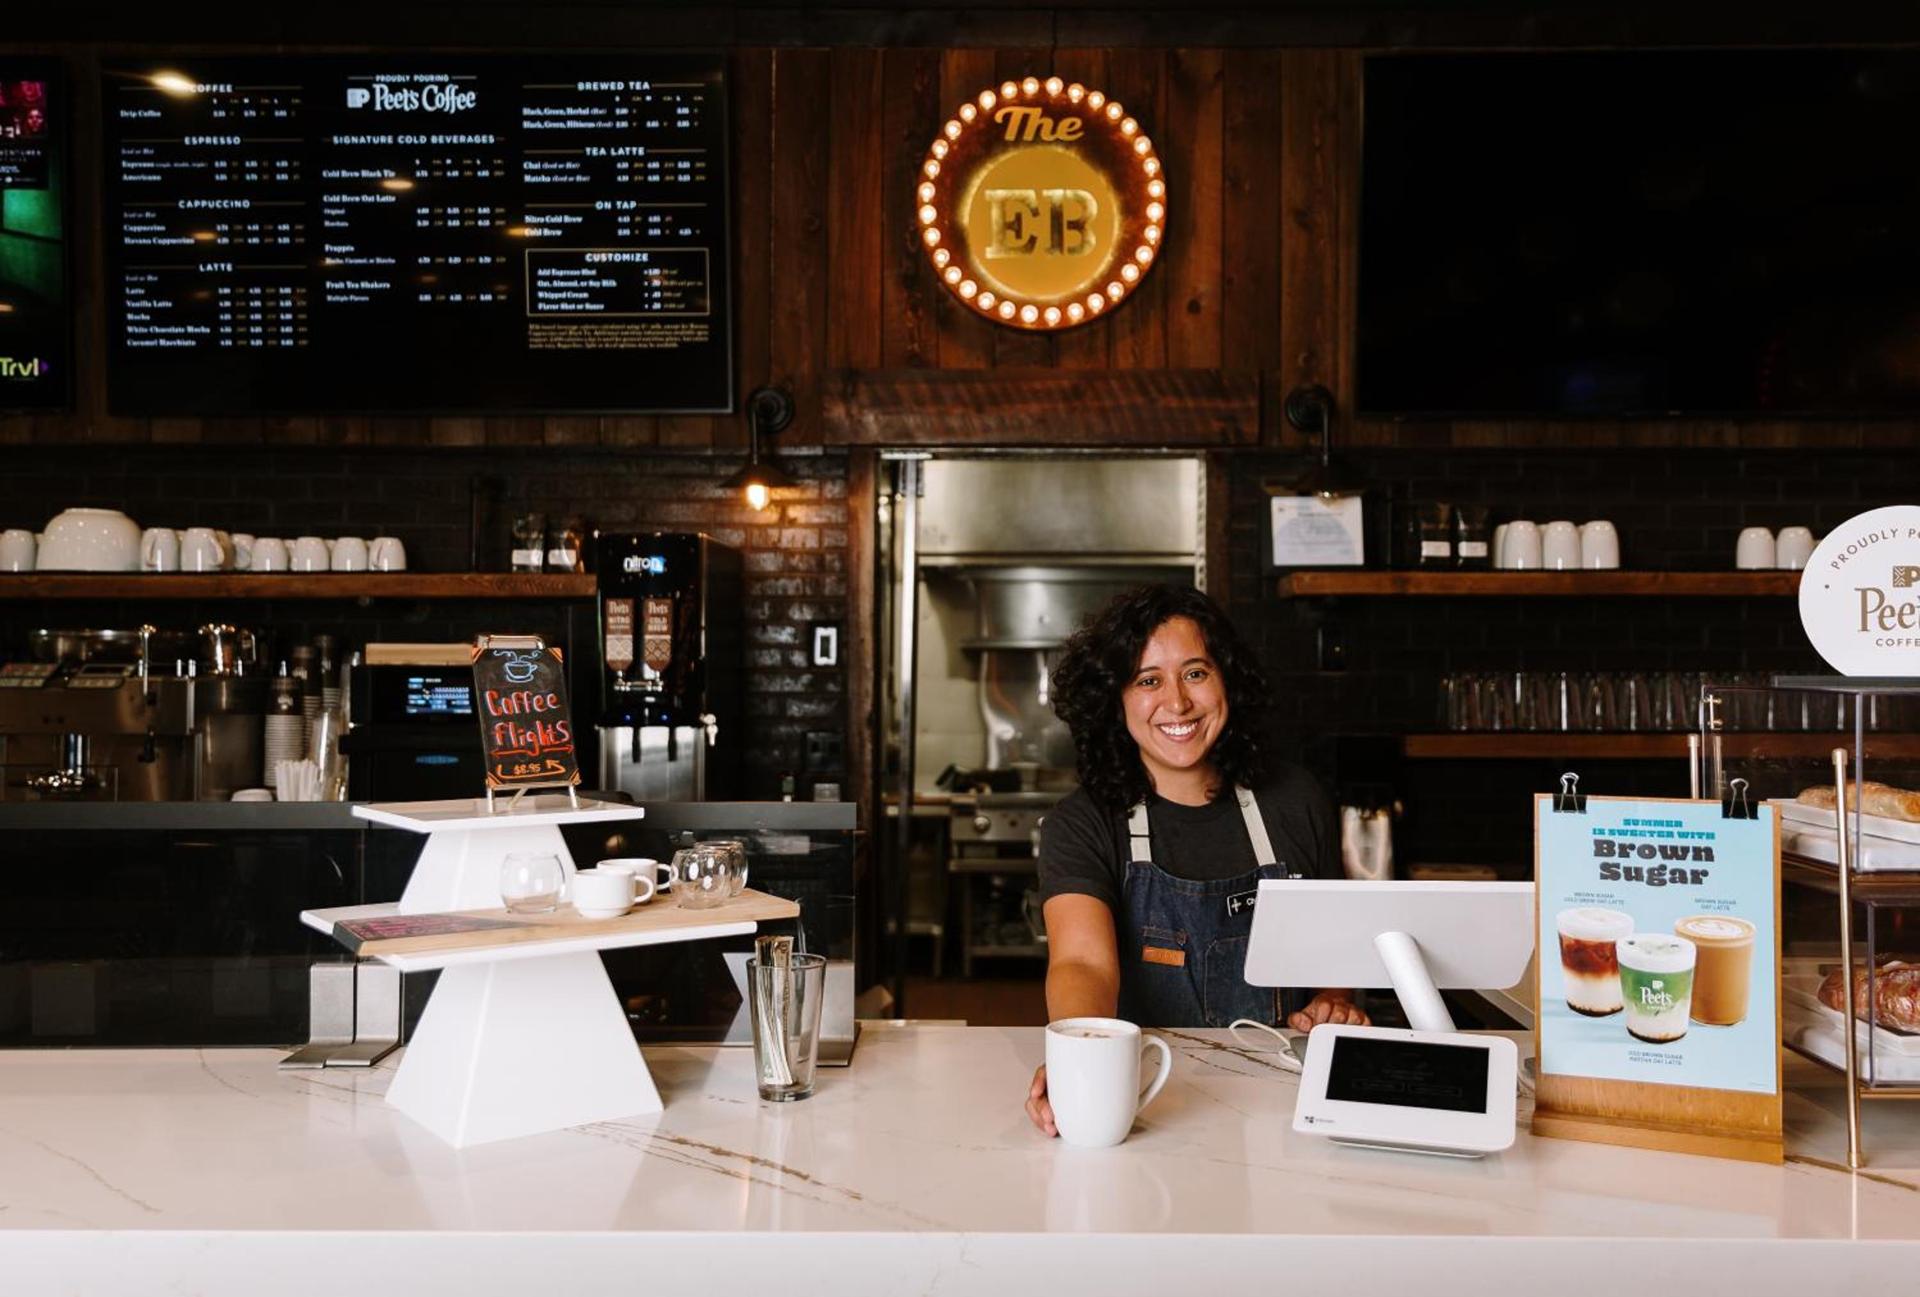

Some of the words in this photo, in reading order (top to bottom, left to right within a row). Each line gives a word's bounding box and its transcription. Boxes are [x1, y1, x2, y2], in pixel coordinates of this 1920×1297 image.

[577, 82, 624, 90] BREWED
[629, 82, 650, 90] TEA
[422, 84, 477, 114] Coffee
[138, 110, 161, 118] Coffee
[994, 106, 1084, 141] The
[184, 136, 241, 145] ESPRESSO
[333, 135, 393, 144] SIGNATURE
[398, 135, 427, 144] COLD
[431, 135, 495, 144] BEVERAGES
[585, 147, 606, 155] TEA
[611, 147, 645, 155] LATTE
[178, 200, 250, 208] CAPPUCCINO
[595, 201, 611, 210] ON
[616, 201, 637, 210] TAP
[984, 189, 1098, 259] EB
[585, 253, 649, 262] CUSTOMIZE
[199, 263, 233, 272] LATTE
[1830, 528, 1899, 570] PROUDLY
[486, 690, 560, 716] Coffee
[514, 763, 541, 775] $8.95
[1623, 819, 1683, 828] SUMMER
[1608, 829, 1674, 838] SWEETER
[1677, 831, 1715, 840] WITH
[1593, 839, 1715, 862] Brown
[1599, 862, 1709, 886] Sugar
